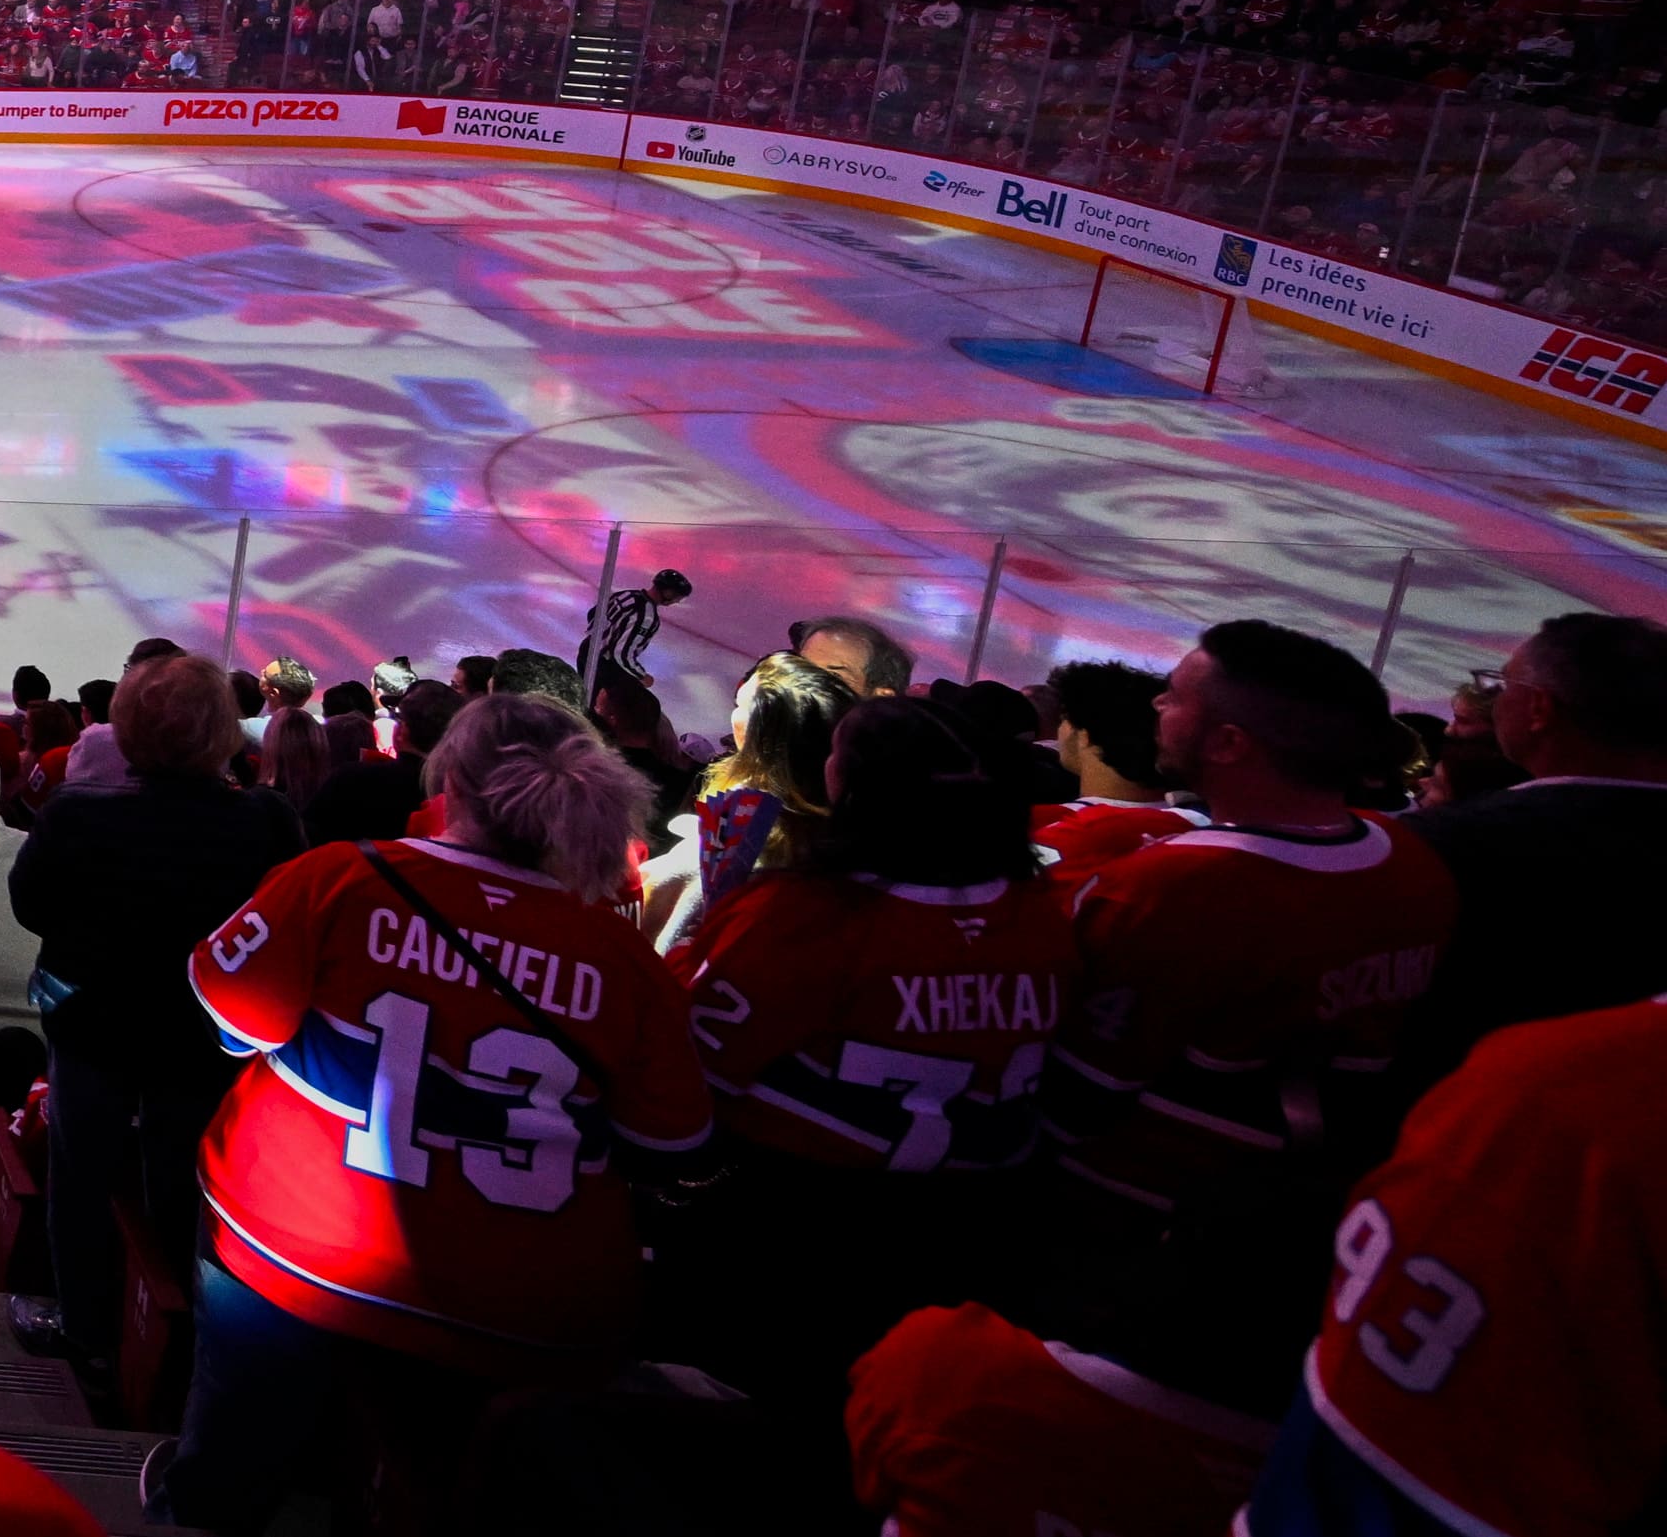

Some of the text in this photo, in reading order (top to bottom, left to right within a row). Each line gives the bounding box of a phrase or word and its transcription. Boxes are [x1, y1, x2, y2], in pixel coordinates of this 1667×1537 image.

[49, 105, 65, 118] to
[67, 105, 129, 123] Bumper
[164, 99, 340, 127] pizza pizza
[453, 121, 566, 145] NATIONALE
[456, 106, 541, 126] BANQUE
[678, 144, 736, 168] YouTube
[787, 151, 887, 181] ABRYSVO
[947, 179, 986, 200] Pfizer
[996, 179, 1069, 229] Bell
[1078, 200, 1151, 233] Tout part
[1073, 219, 1199, 267] d'une connexion
[1216, 266, 1247, 287] RBC
[1268, 249, 1368, 293] Les idées
[1260, 276, 1431, 340] prennent vie ici
[1519, 327, 1667, 415] IGA
[210, 910, 271, 974] 3
[367, 907, 604, 1023] CAUFIELD
[690, 978, 751, 1051] 2
[892, 970, 1058, 1035] XHEKAJ
[343, 990, 587, 1214] 13
[1333, 1196, 1489, 1394] 93
